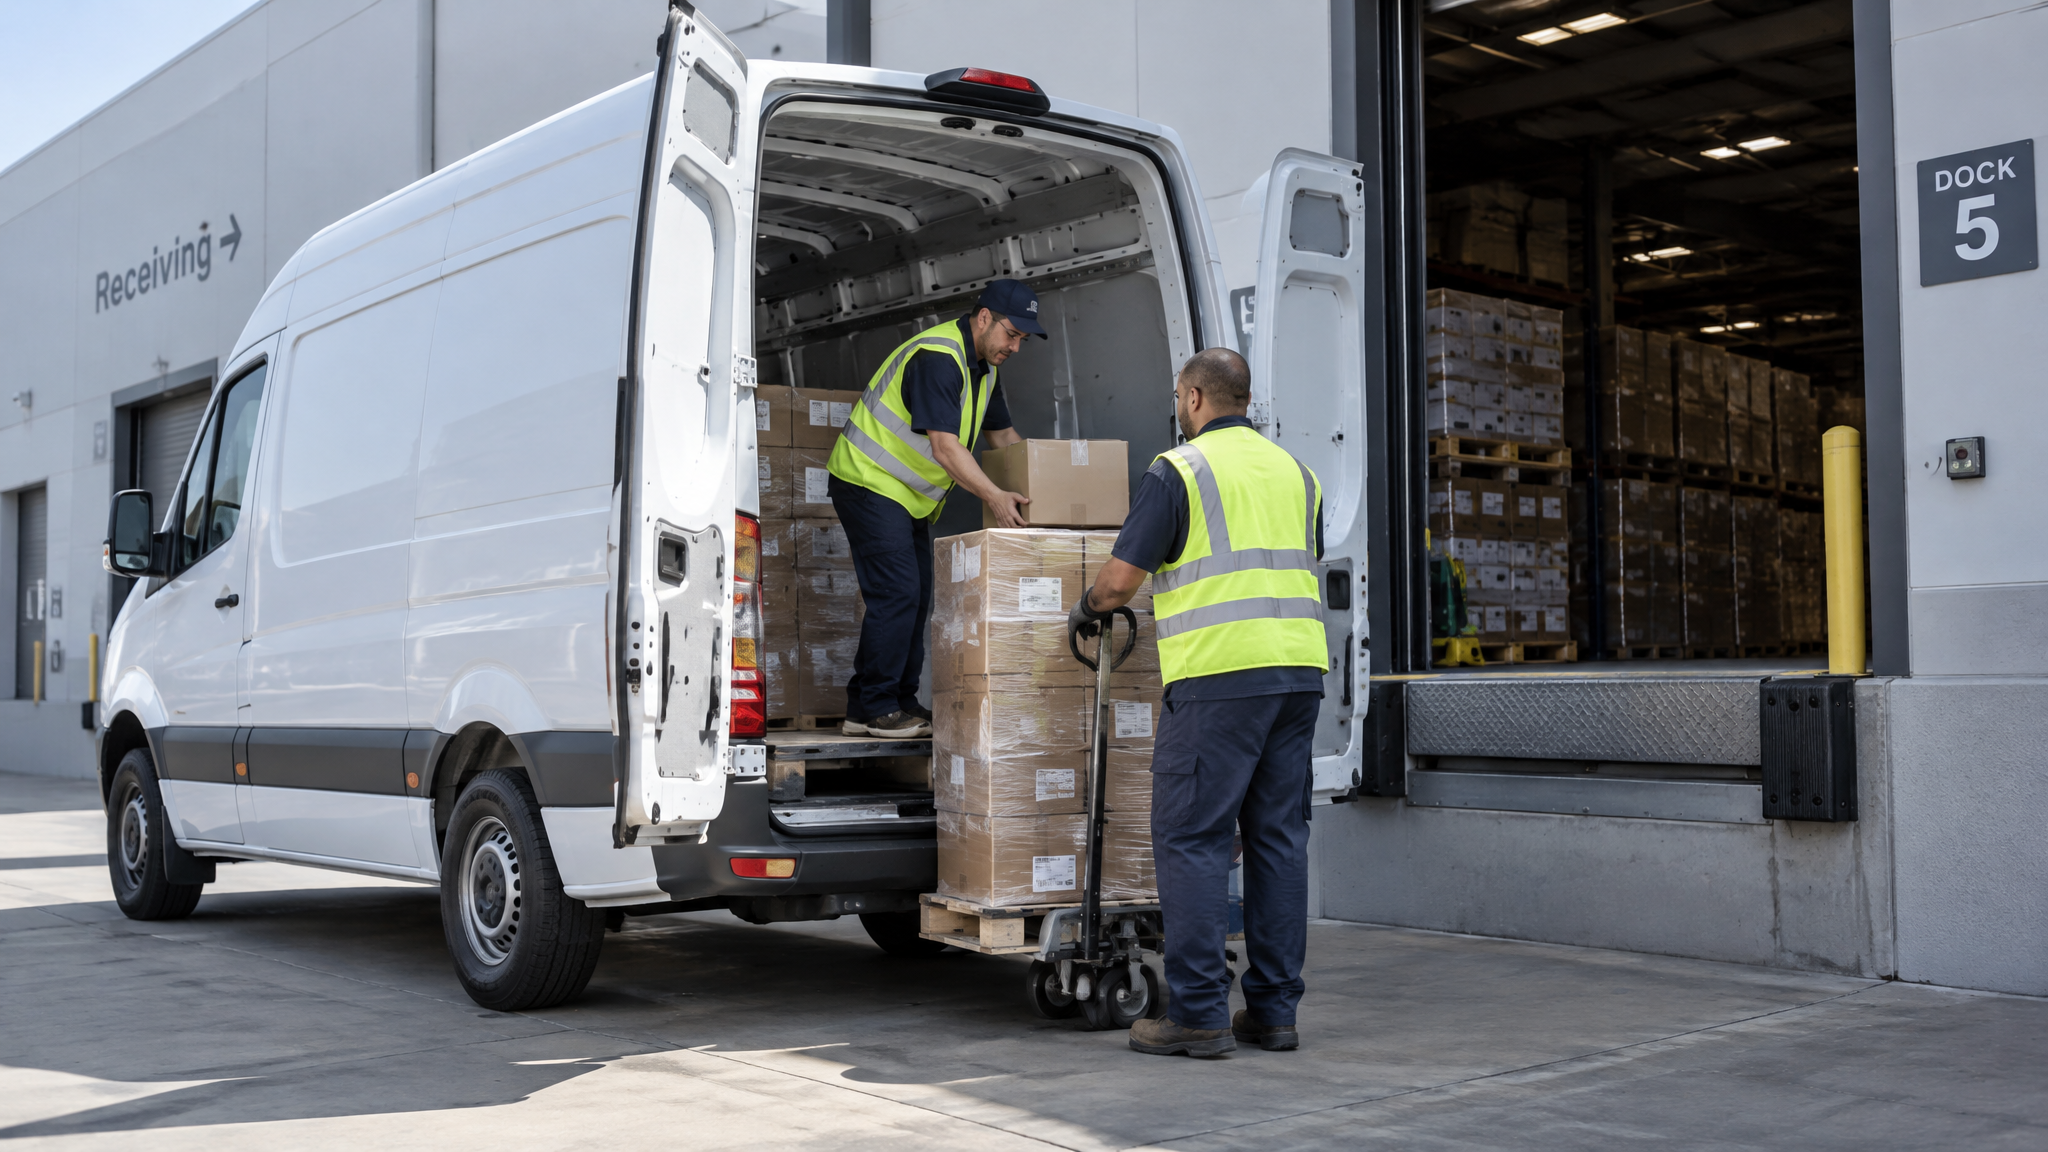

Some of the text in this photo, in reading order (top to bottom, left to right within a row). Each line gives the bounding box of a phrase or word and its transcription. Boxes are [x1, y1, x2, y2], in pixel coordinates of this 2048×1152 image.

[1935, 156, 2016, 192] DOCK
[1954, 193, 2000, 261] 5
[95, 233, 211, 314] Receiving
